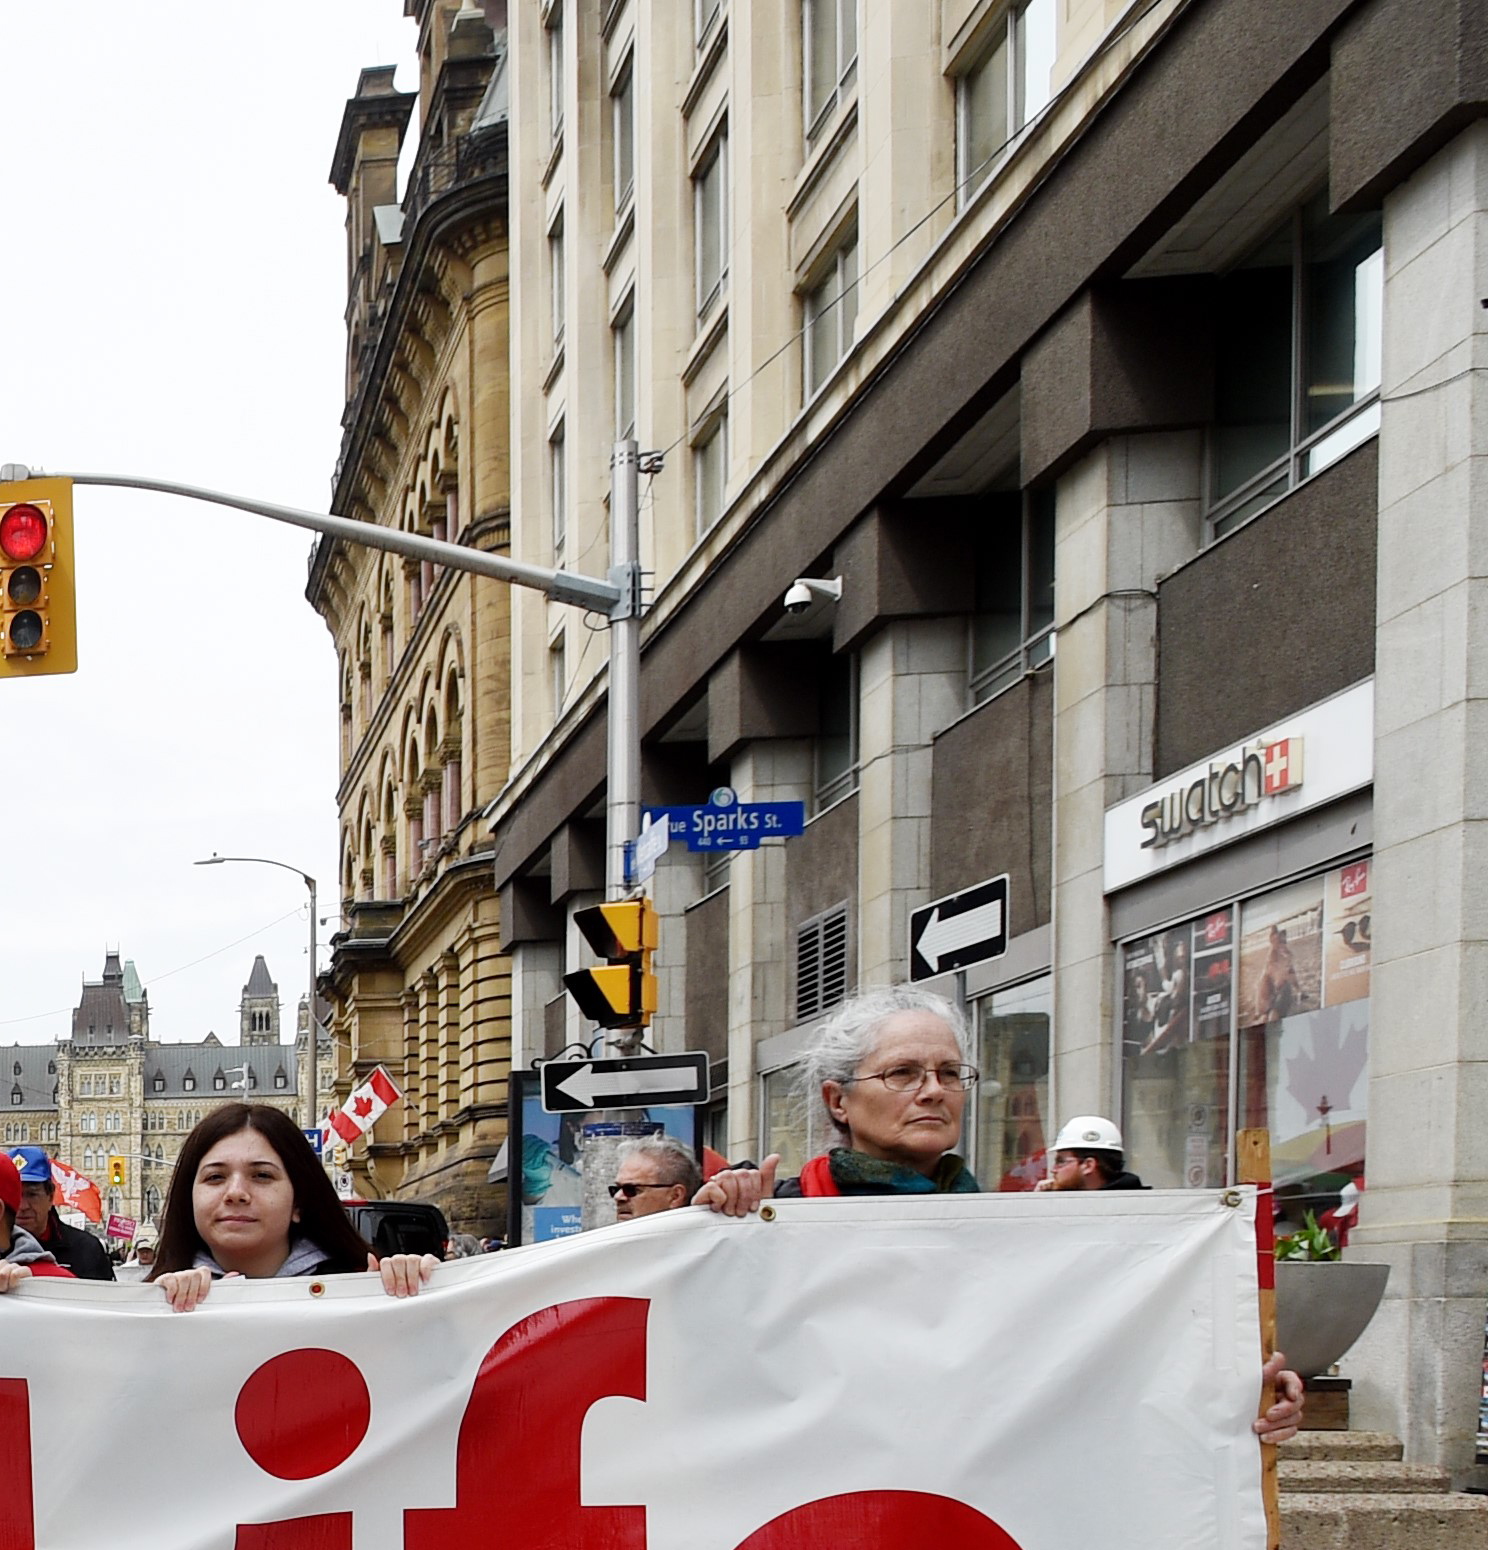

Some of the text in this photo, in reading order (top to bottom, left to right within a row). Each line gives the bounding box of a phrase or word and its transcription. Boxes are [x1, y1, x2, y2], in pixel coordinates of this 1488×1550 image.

[668, 806, 783, 837] ue Sparks St.
[1140, 746, 1263, 850] swatch
